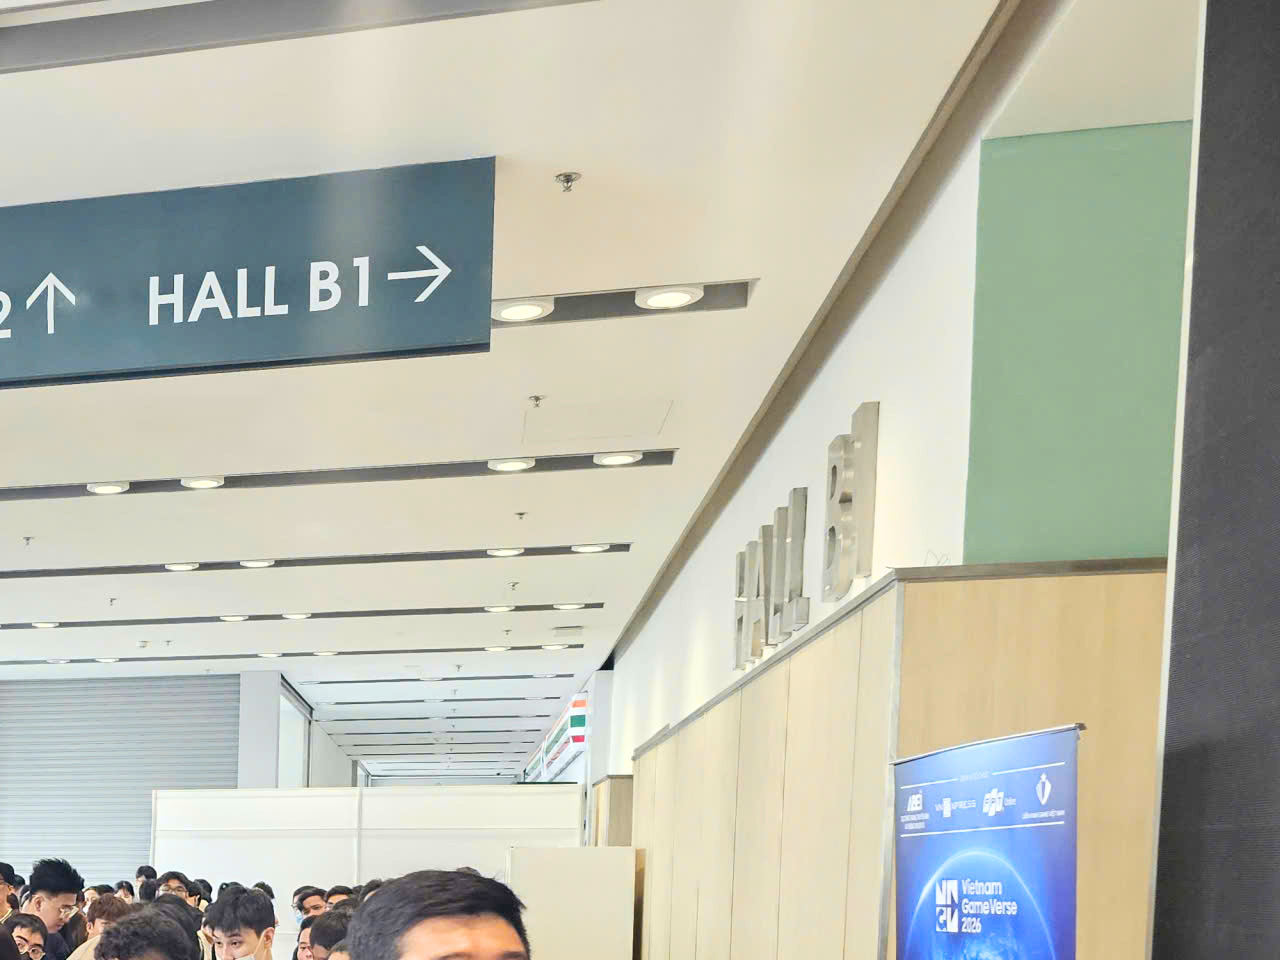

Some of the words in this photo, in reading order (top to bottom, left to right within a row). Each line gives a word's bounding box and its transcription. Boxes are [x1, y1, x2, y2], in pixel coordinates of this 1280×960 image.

[149, 265, 289, 326] HALL
[308, 255, 370, 312] B1
[961, 878, 1002, 896] Vietnam
[961, 898, 1018, 915] GameVerse
[961, 917, 982, 933] 2026
